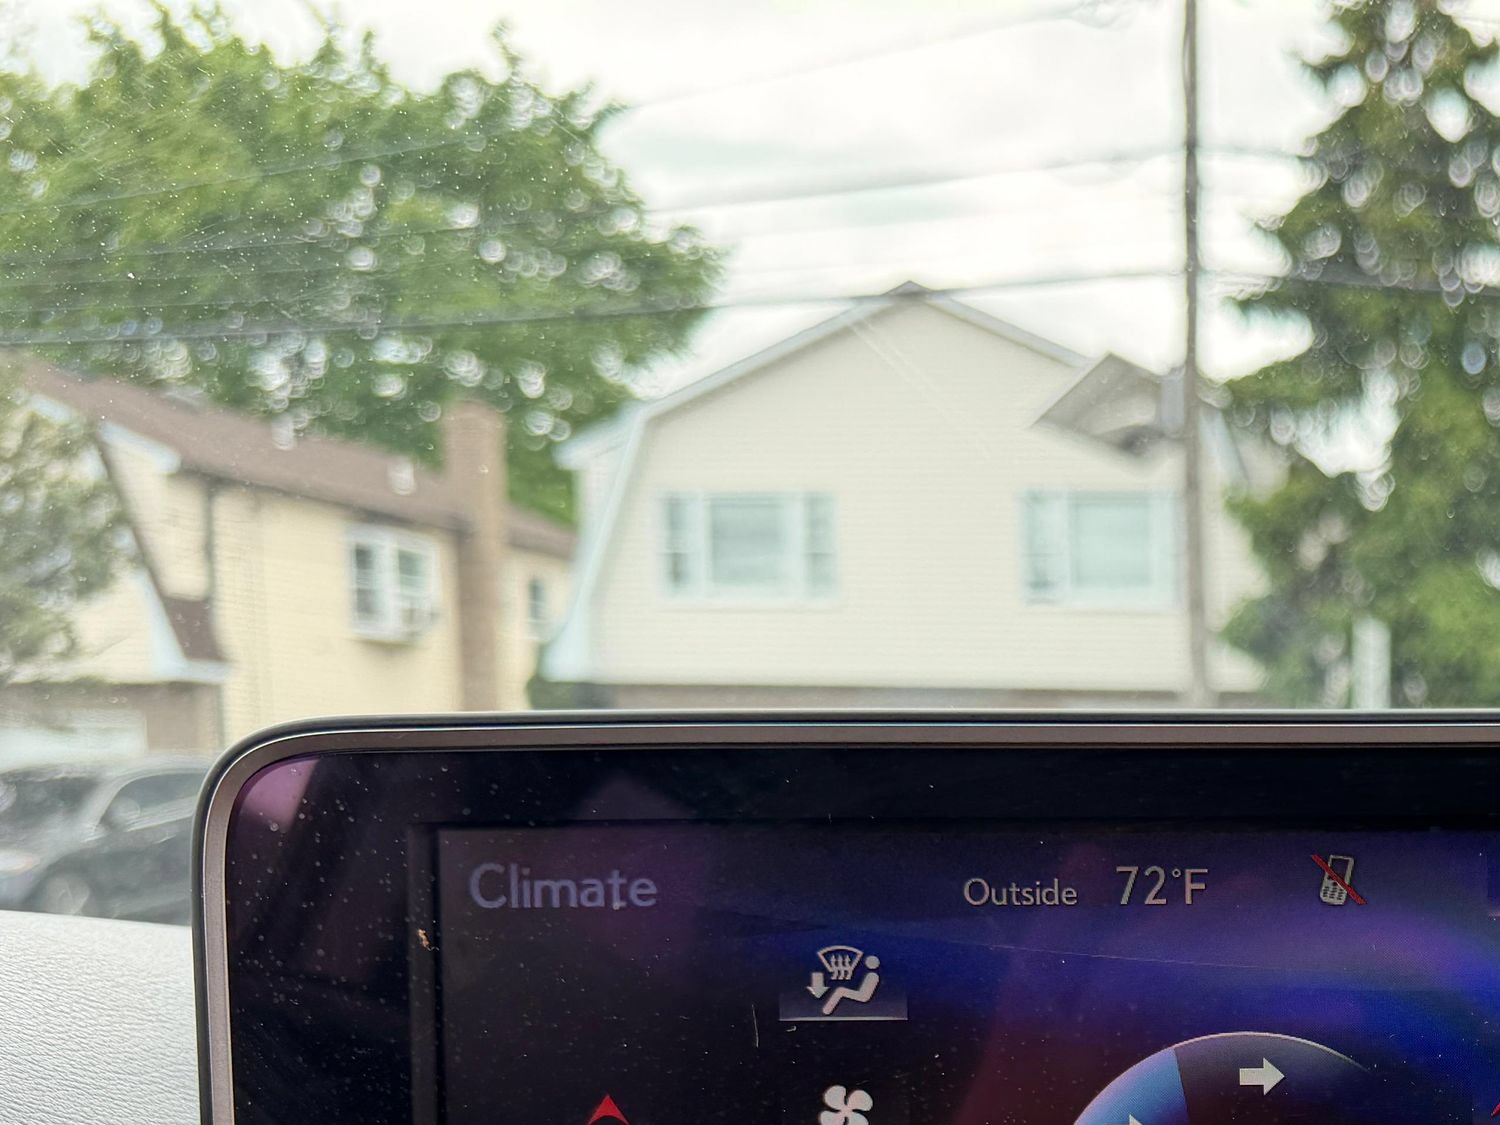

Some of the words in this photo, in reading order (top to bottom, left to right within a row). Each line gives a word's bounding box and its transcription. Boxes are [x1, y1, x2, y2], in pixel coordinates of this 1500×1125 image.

[470, 862, 658, 909] Climate
[962, 877, 1078, 906] Outside
[1114, 866, 1208, 906] 72°F
